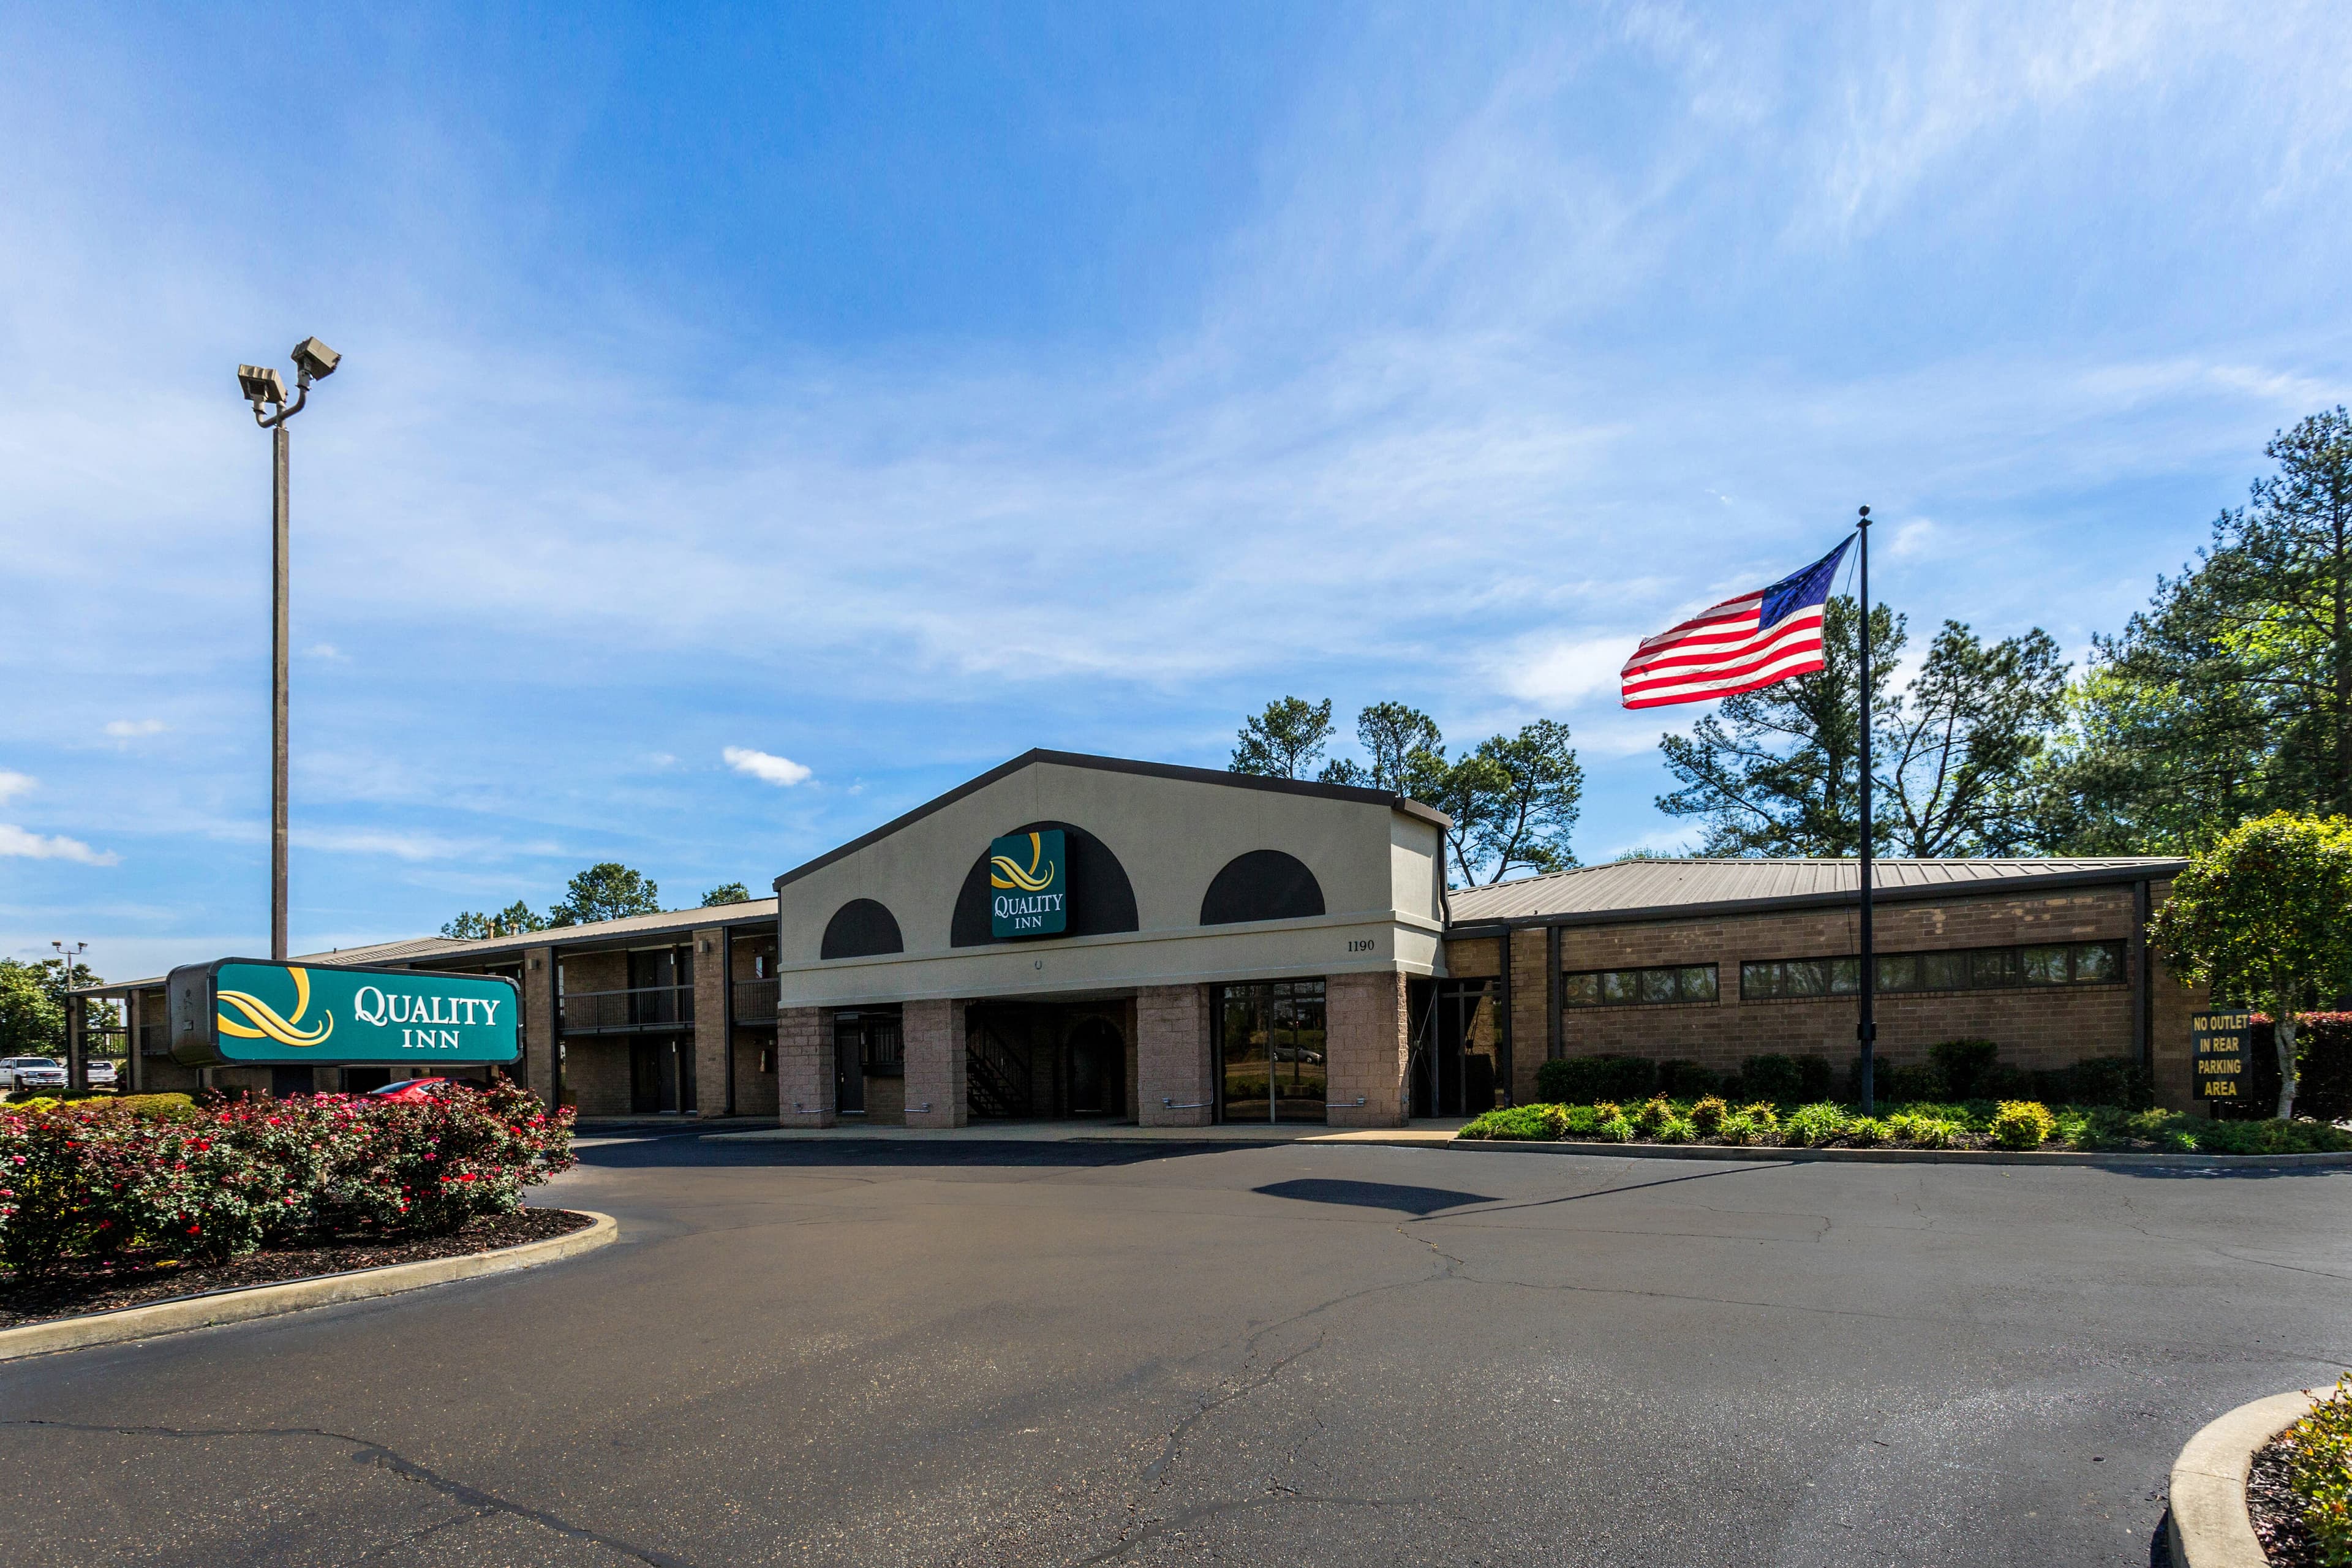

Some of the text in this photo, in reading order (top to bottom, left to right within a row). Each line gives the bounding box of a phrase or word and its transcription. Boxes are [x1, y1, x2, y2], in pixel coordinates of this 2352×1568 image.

[995, 894, 1063, 918] QUALITY
[1015, 916, 1042, 929] INN
[1348, 940, 1374, 952] 1190
[354, 986, 500, 1027] QUALITY
[2194, 1014, 2248, 1031] NO OUTLET
[402, 1029, 459, 1048] INN
[2200, 1037, 2239, 1052] IN REAR
[2198, 1059, 2241, 1074] PARKING
[2205, 1082, 2237, 1095] AREA
